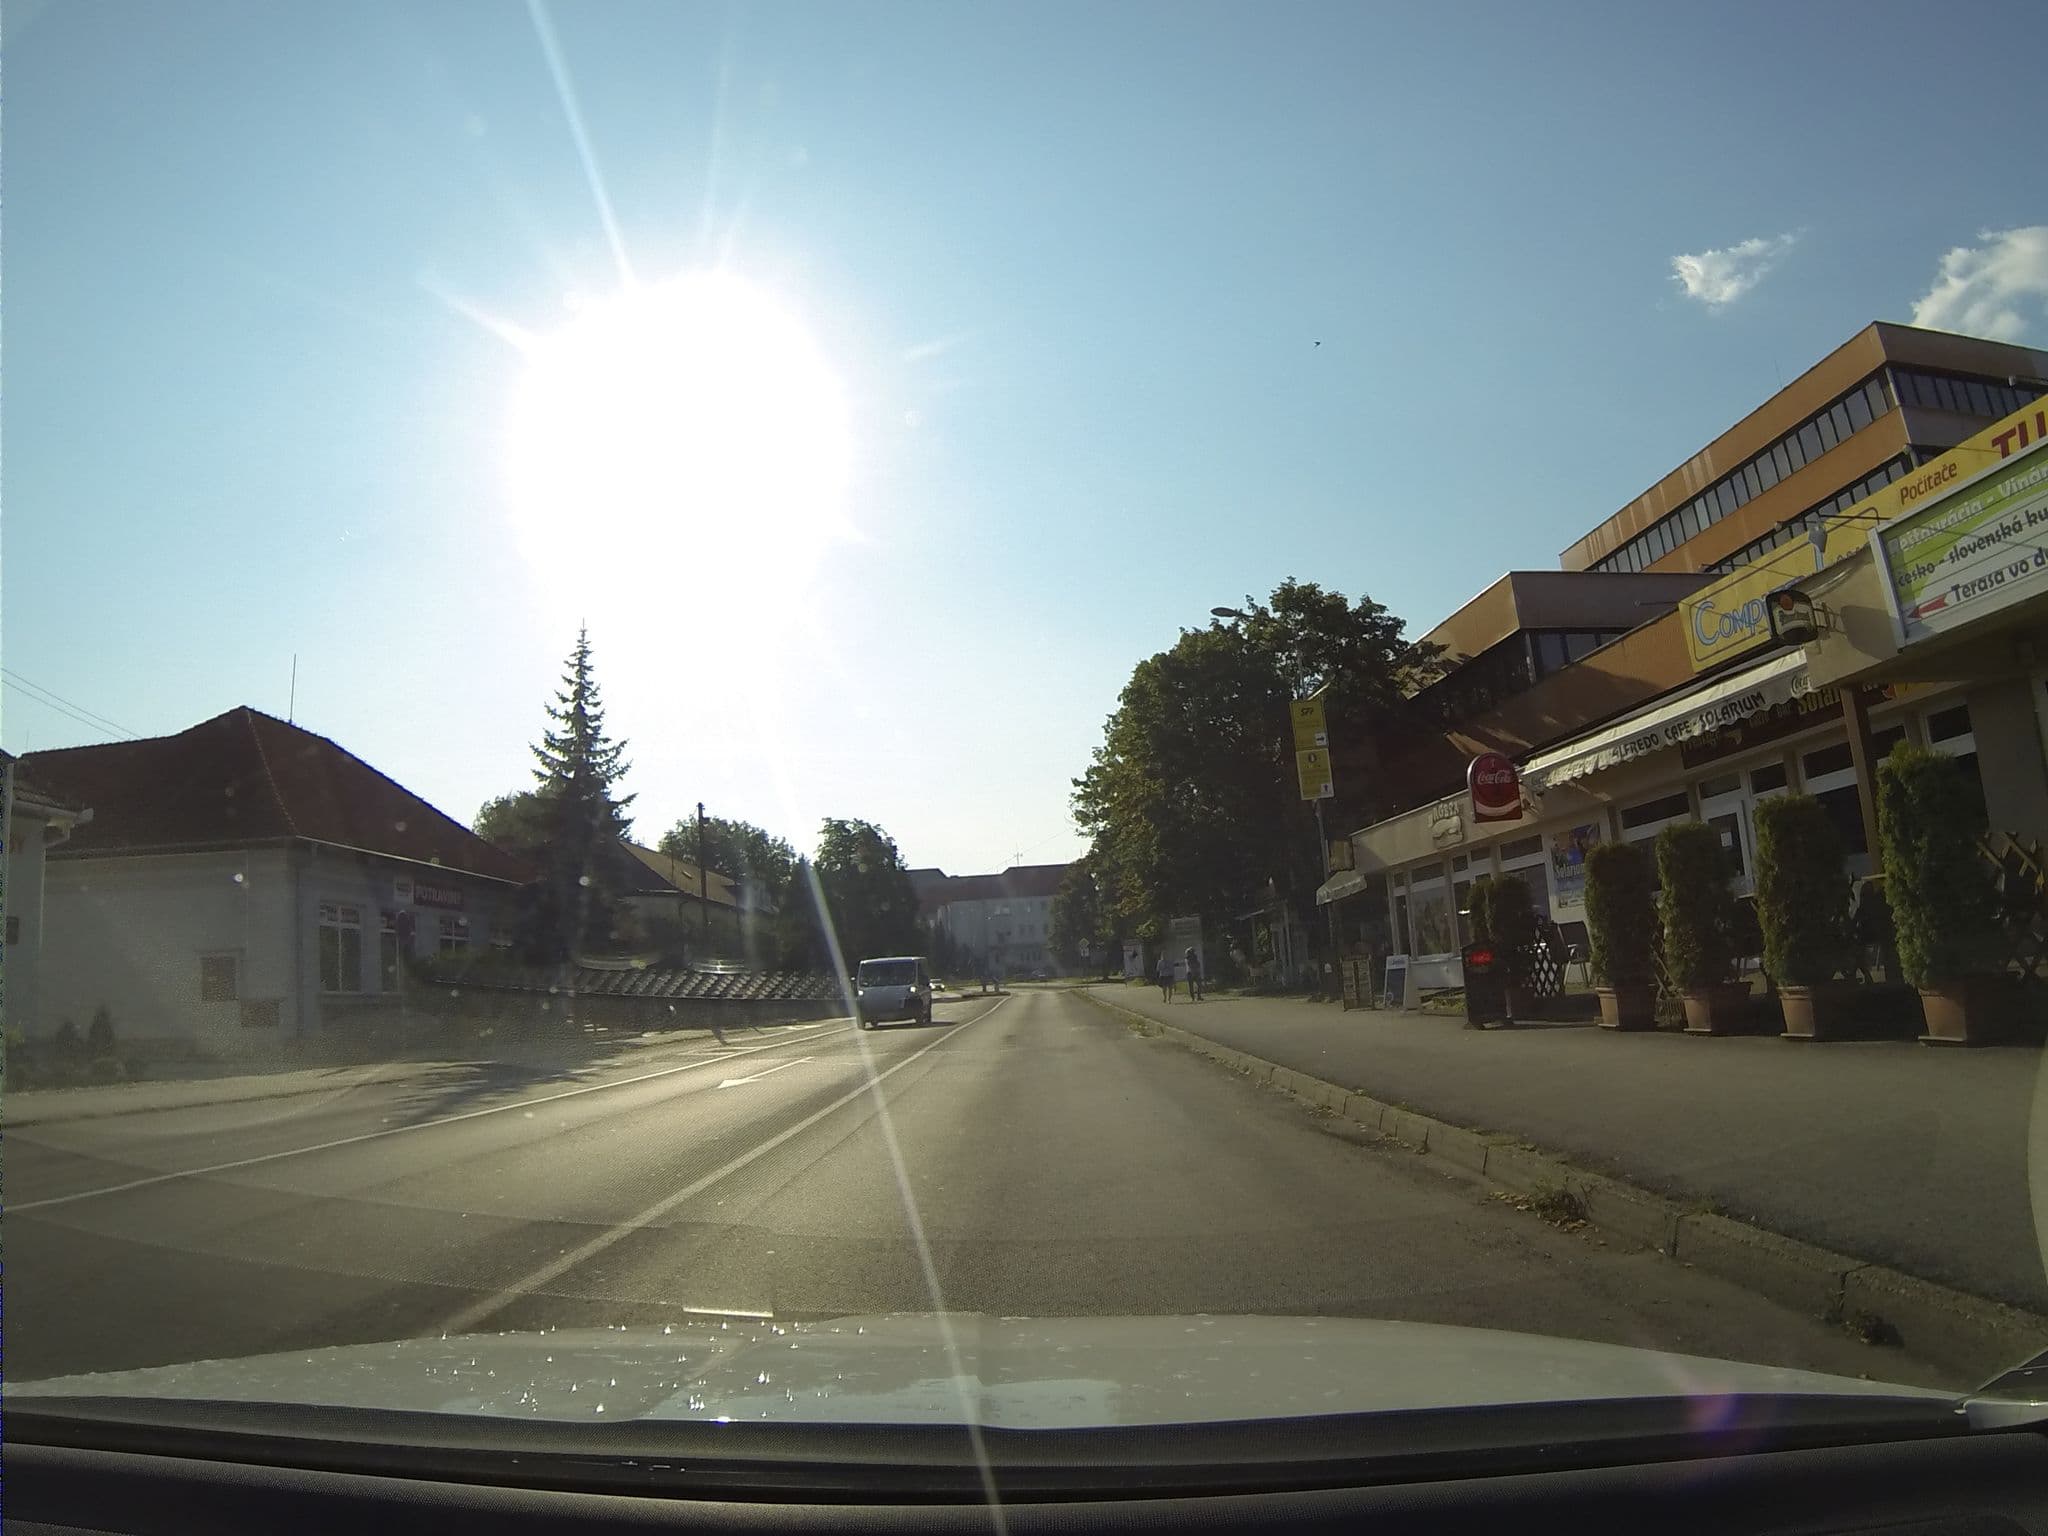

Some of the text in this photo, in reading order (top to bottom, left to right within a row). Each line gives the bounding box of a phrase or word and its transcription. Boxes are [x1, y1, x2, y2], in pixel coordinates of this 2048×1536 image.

[1900, 462, 1957, 505] Počítače
[1948, 515, 2024, 565] slovenská
[1951, 546, 2048, 603] Terasa vo d
[1664, 720, 1692, 741] CAFE
[1699, 691, 1767, 729] SOLARIUM
